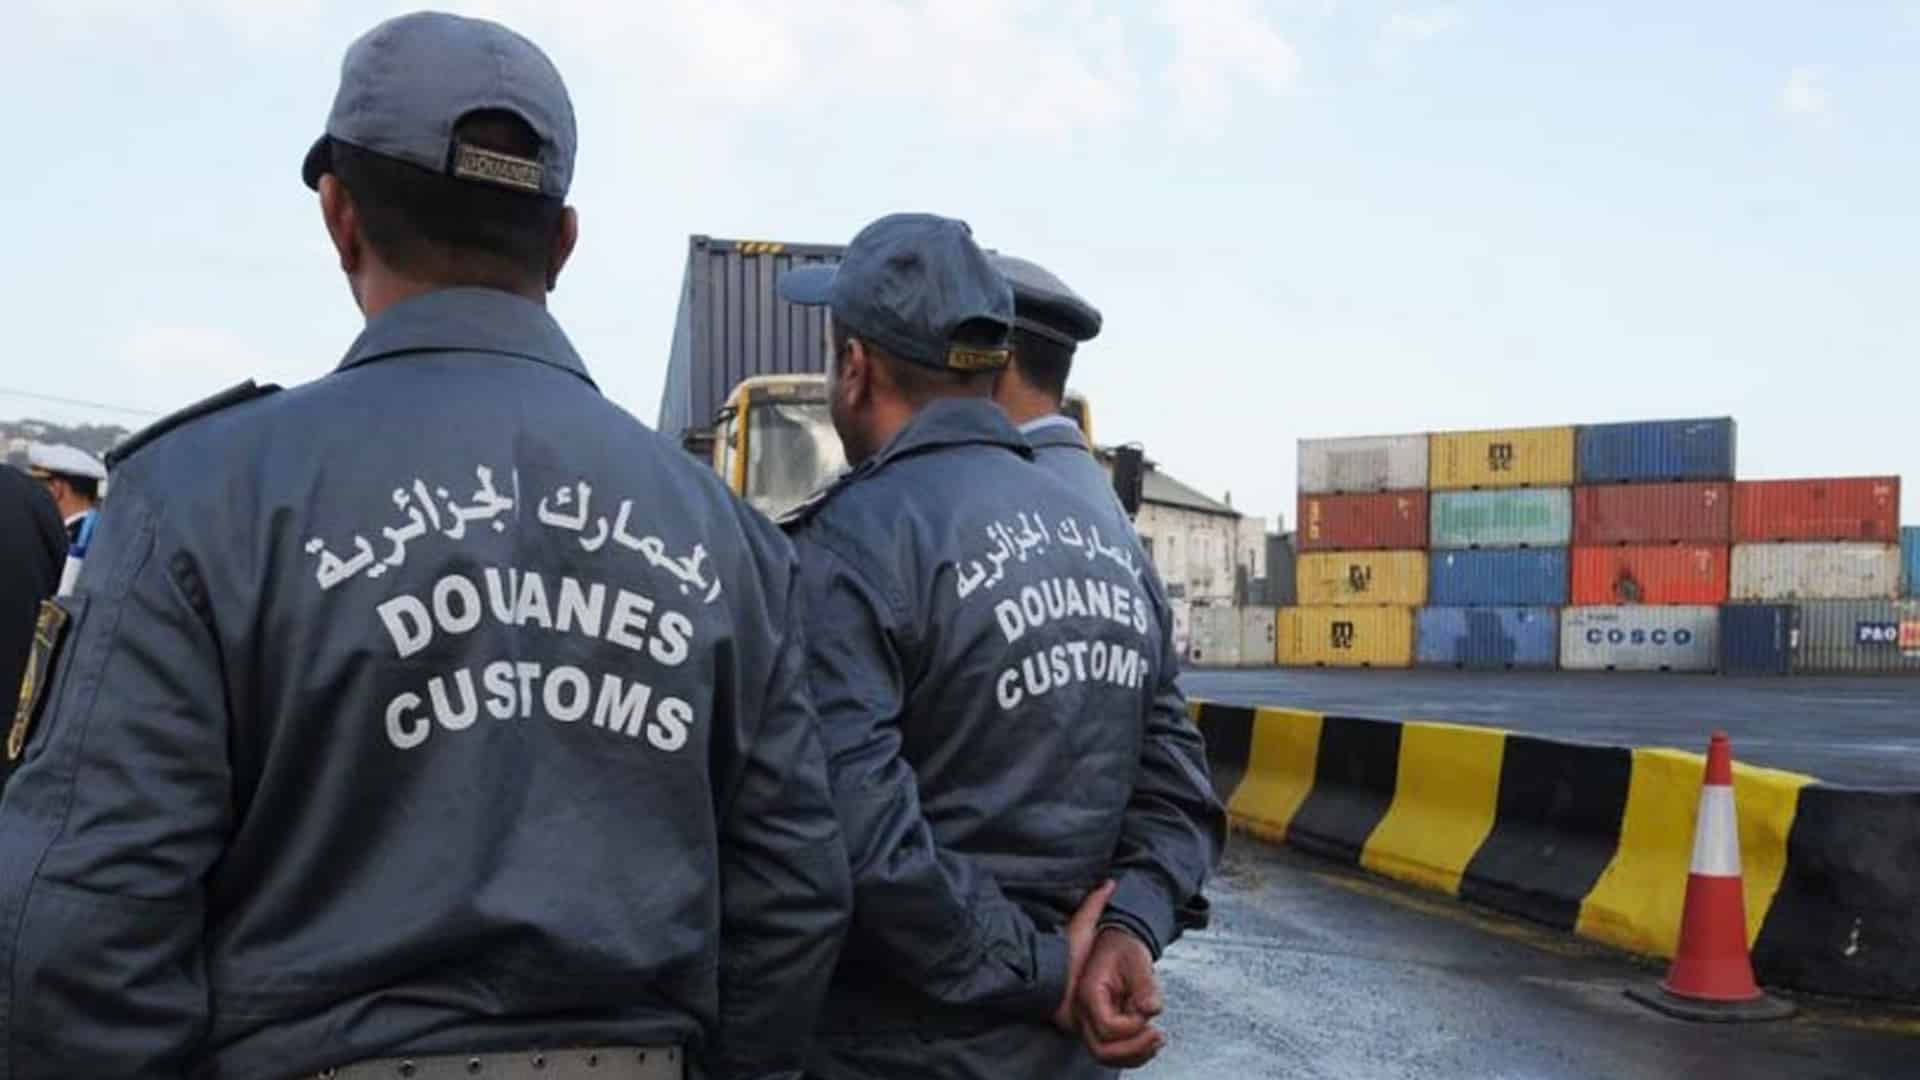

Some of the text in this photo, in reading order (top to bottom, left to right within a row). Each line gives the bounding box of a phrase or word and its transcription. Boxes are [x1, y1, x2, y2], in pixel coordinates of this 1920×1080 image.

[537, 481, 722, 603] الجمارك
[376, 567, 694, 666] DOUANES
[994, 577, 1147, 644] DOUANES
[1586, 628, 1692, 645] COSCO
[385, 661, 694, 752] CUSTOMS
